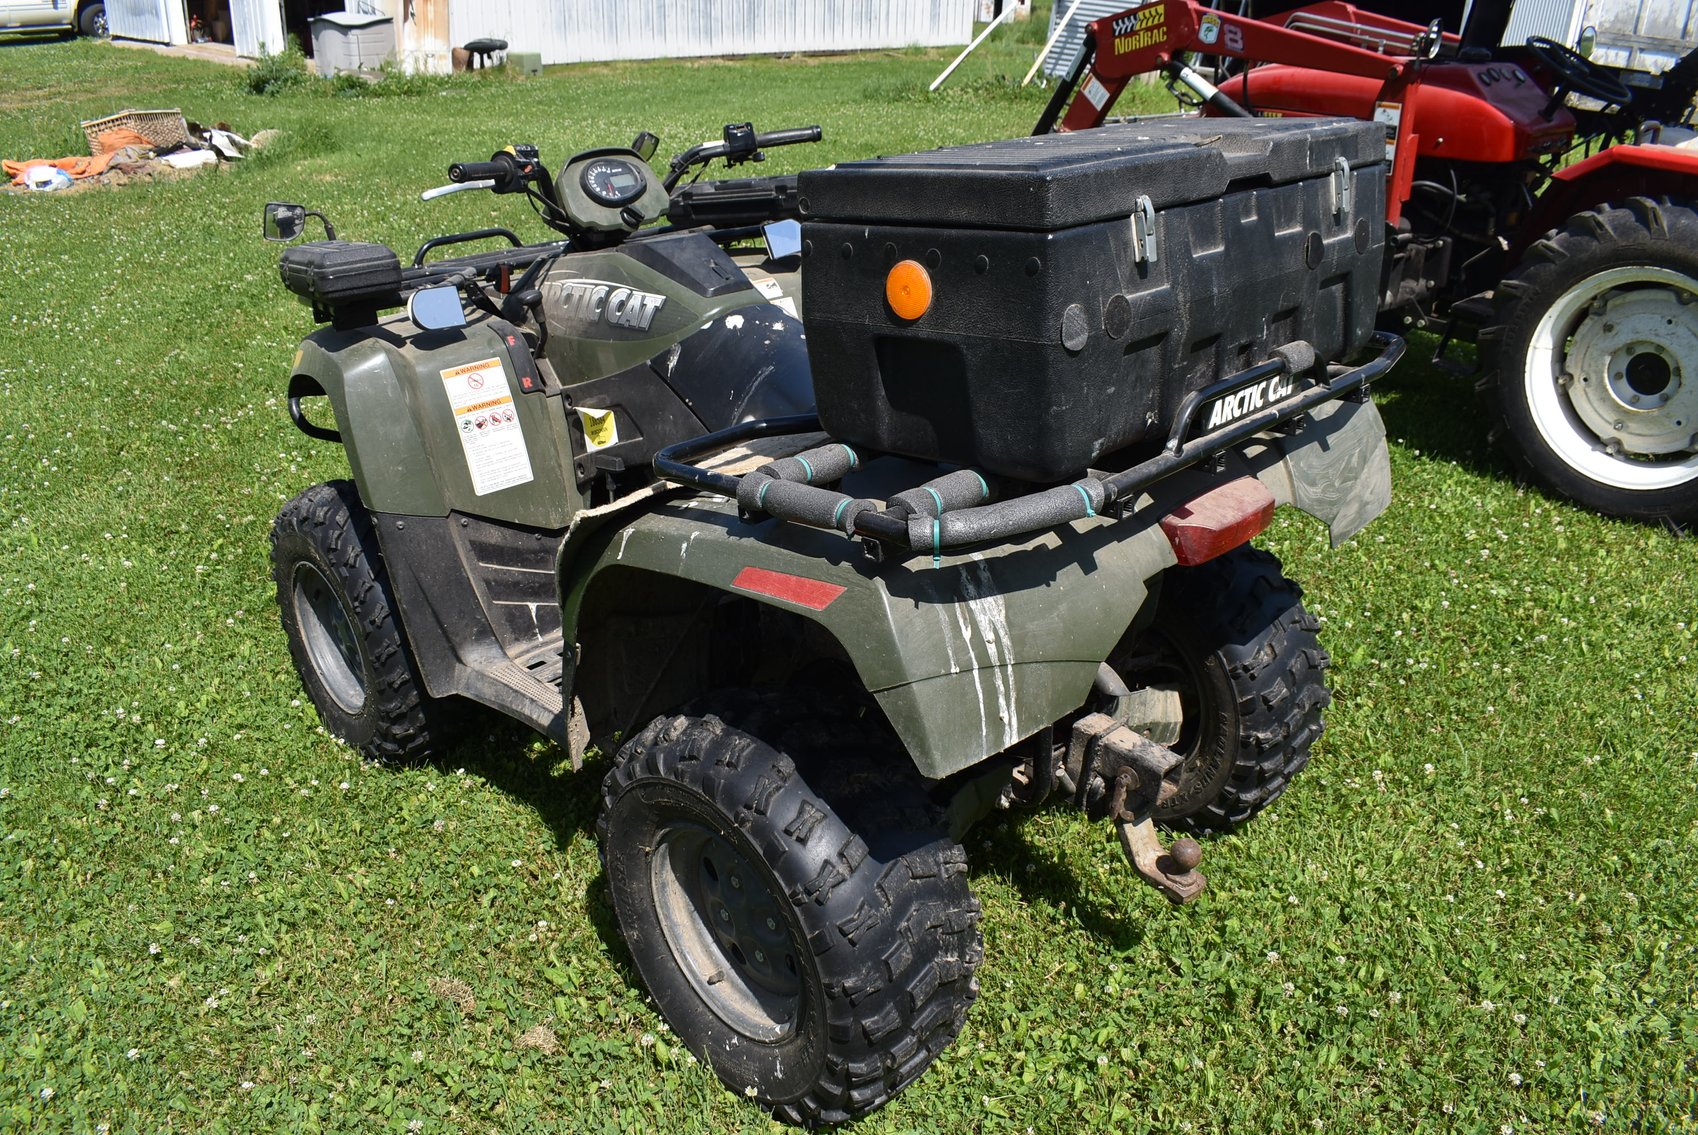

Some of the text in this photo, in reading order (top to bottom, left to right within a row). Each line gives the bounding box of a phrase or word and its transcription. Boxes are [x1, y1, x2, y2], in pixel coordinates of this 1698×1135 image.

[605, 287, 667, 332] CAT
[506, 335, 516, 346] F
[460, 362, 490, 374] WARNING
[521, 377, 533, 389] R
[471, 398, 502, 411] WARNING
[1208, 381, 1267, 430] ARCTIC
